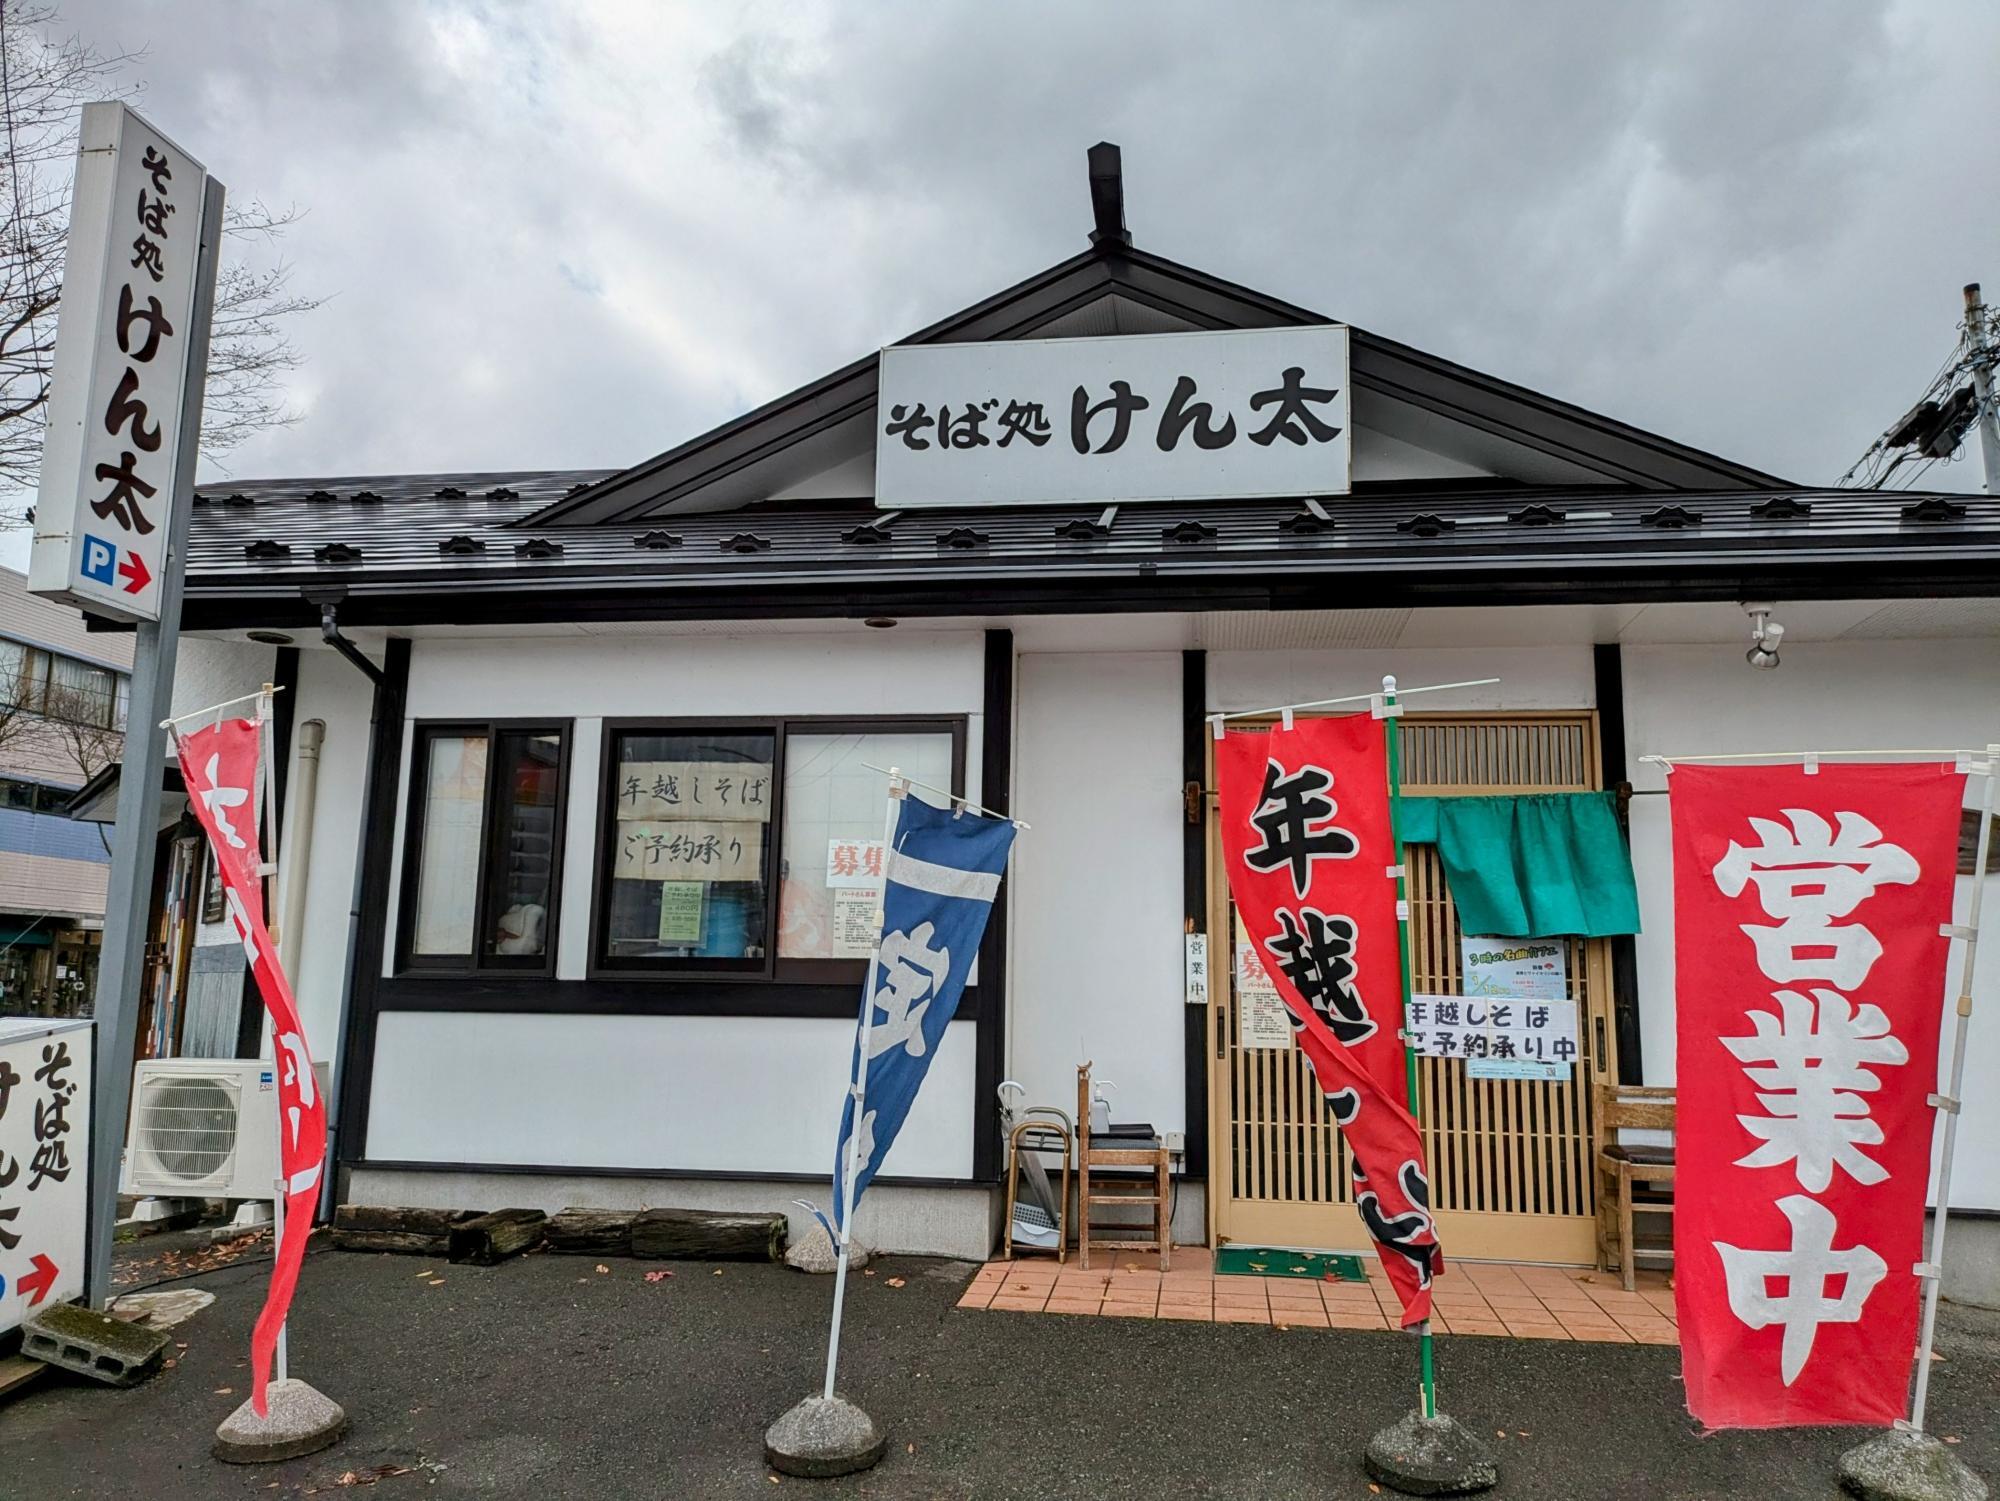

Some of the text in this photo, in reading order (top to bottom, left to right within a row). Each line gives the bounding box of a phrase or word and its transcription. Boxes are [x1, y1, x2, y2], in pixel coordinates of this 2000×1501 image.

[89, 144, 176, 536] そば処 けん太
[885, 366, 1343, 455] そば処 けん太
[620, 774, 769, 806] 年越しそば
[624, 833, 742, 865] ご予約承り
[831, 845, 884, 877] 募集
[1190, 940, 1204, 996] 営業中
[1411, 1001, 1549, 1029] 年越しそば
[1413, 1031, 1577, 1062] ご予約承り中
[27, 1041, 77, 1192] そば処
[1711, 807, 1920, 1388] 営業中
